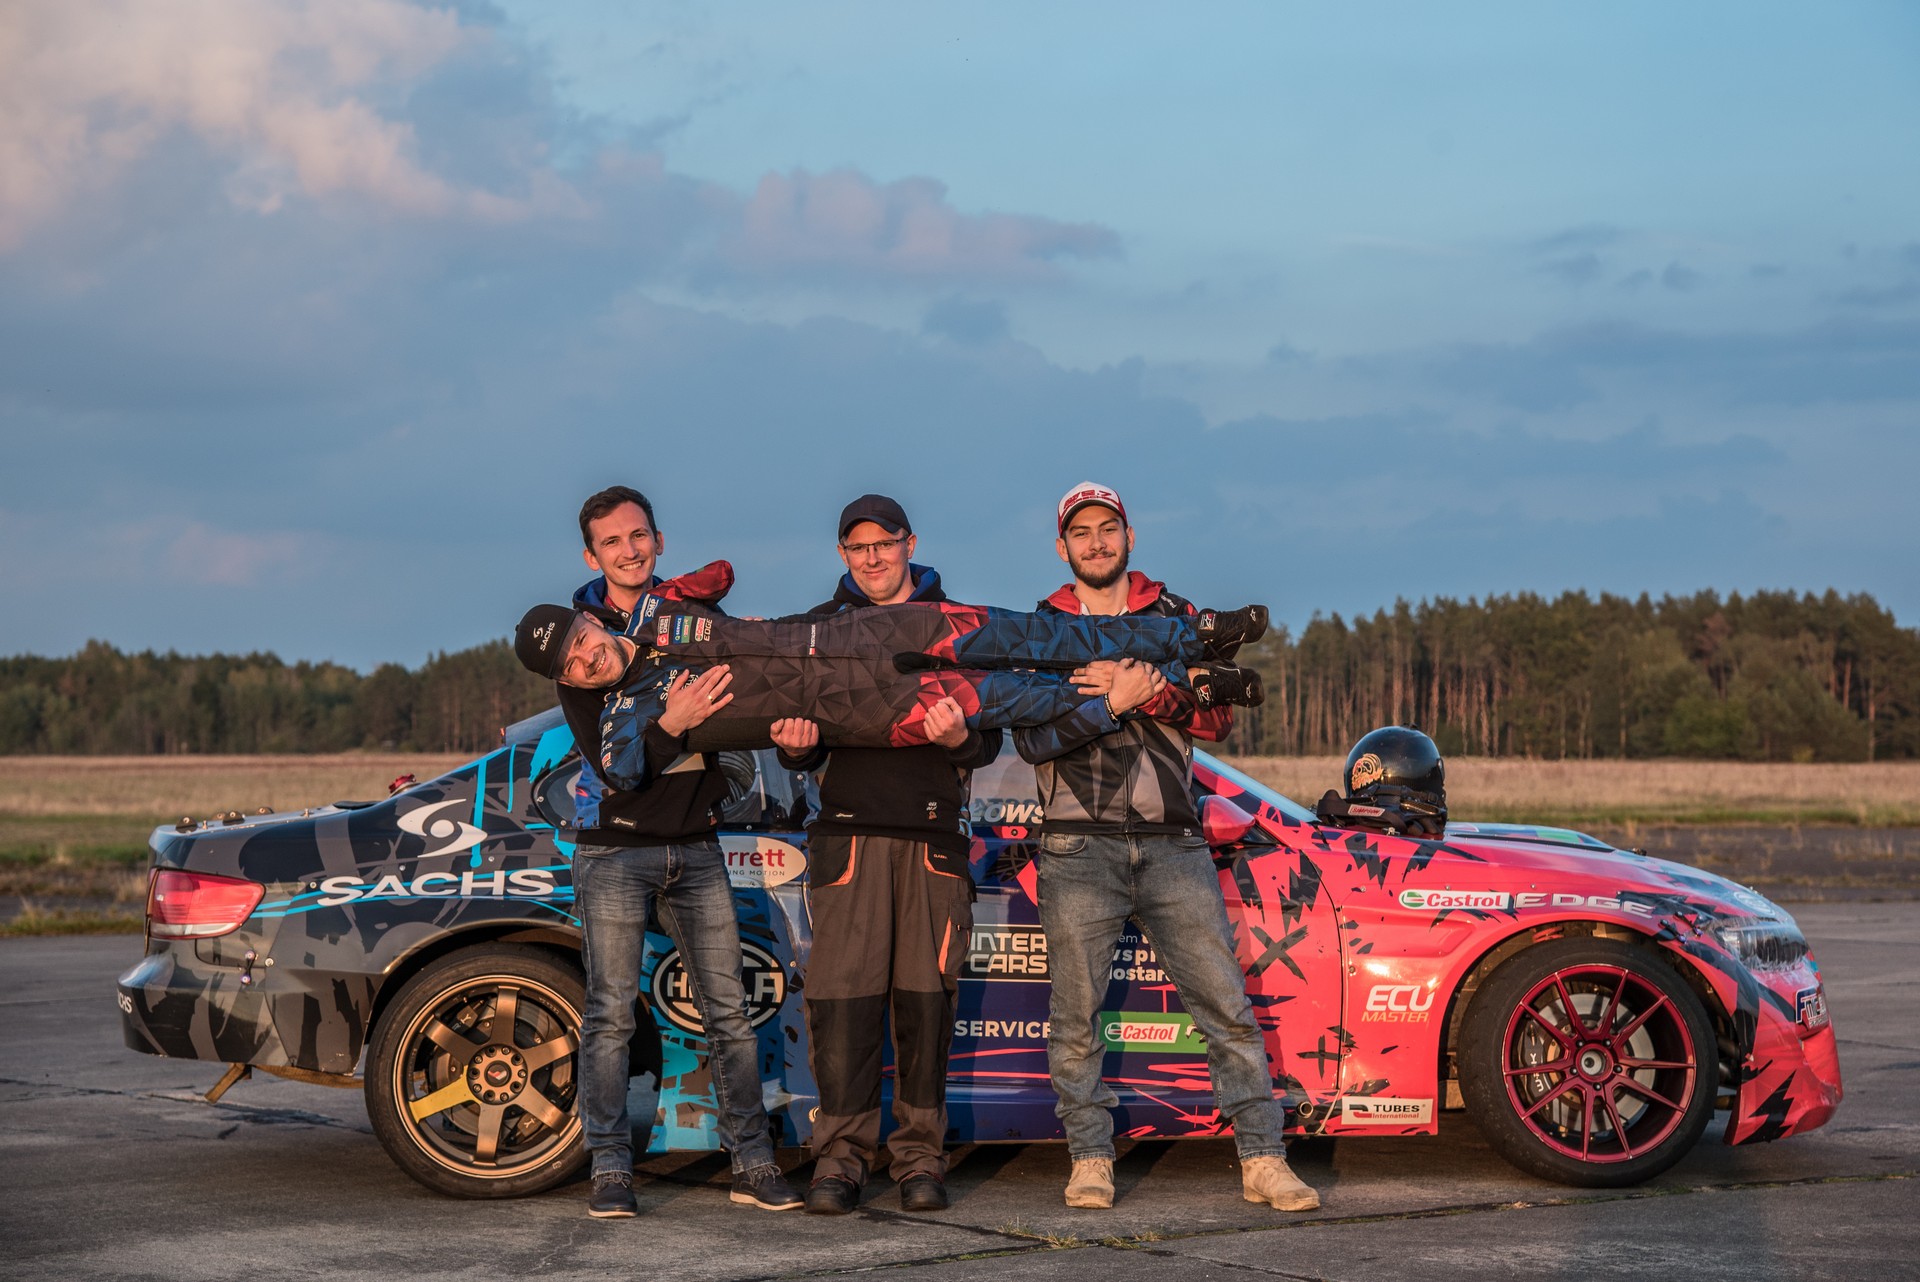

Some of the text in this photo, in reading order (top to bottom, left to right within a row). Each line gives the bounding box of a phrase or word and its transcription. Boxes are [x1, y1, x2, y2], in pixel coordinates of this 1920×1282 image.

[540, 622, 555, 651] SACHS
[704, 618, 712, 641] EDGE
[724, 848, 785, 868] rrett
[317, 869, 554, 907] SACHS
[1426, 892, 1654, 919] Castrol EDGE
[970, 932, 1048, 953] INTER
[970, 954, 1048, 974] CARS
[1366, 985, 1435, 1011] ECU
[1361, 1011, 1429, 1022] MASTER
[1123, 1025, 1174, 1040] Castrol
[1373, 1104, 1420, 1112] TUBES
